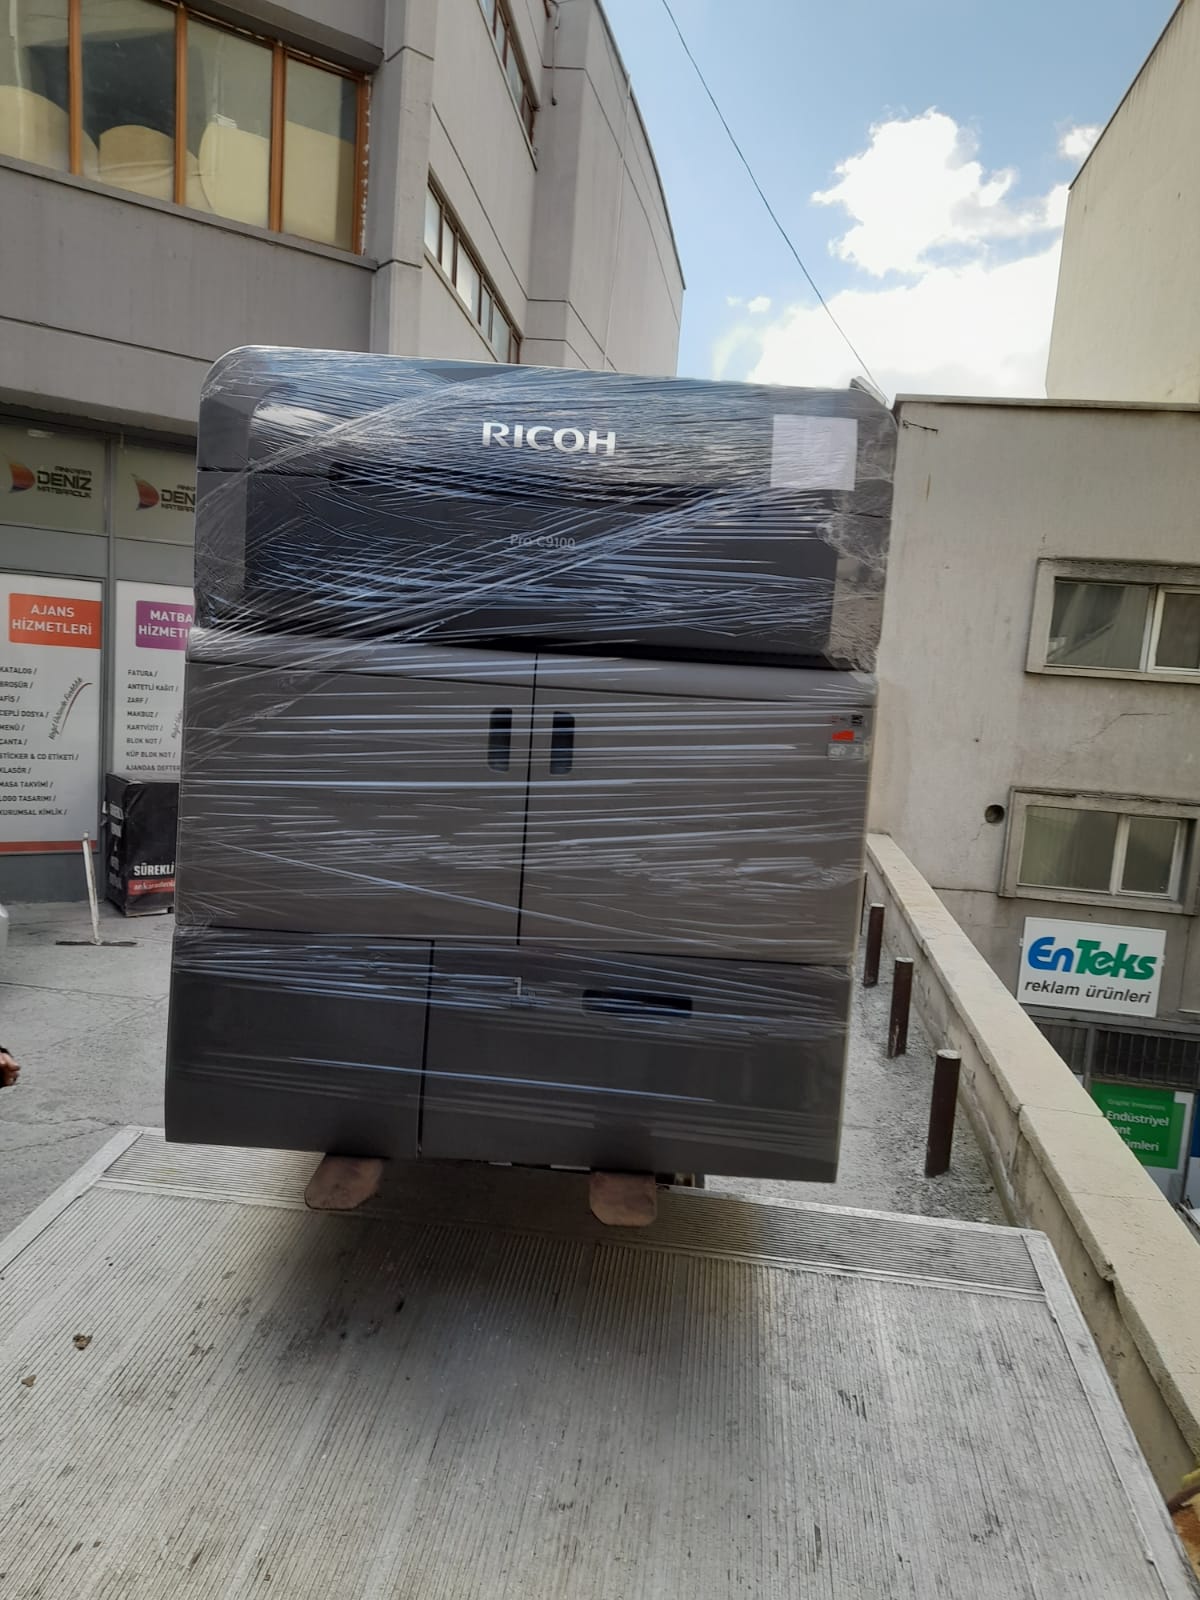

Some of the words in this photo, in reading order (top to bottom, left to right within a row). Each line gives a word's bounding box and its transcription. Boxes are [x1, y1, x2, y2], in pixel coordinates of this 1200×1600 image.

[481, 421, 616, 456] RICOH
[37, 470, 92, 491] DENİZ
[161, 489, 196, 506] DEN
[31, 604, 75, 618] AJANS
[150, 609, 193, 623] MATBA
[11, 619, 92, 636] HİZMETLERİ
[133, 861, 175, 876] SÜREKLİ
[1028, 936, 1158, 981] EnTeks
[1024, 979, 1080, 996] reklam
[1085, 984, 1152, 1004] ürünleri
[1106, 1110, 1170, 1128] Endüstriyel
[1124, 1138, 1160, 1152] ümleri
